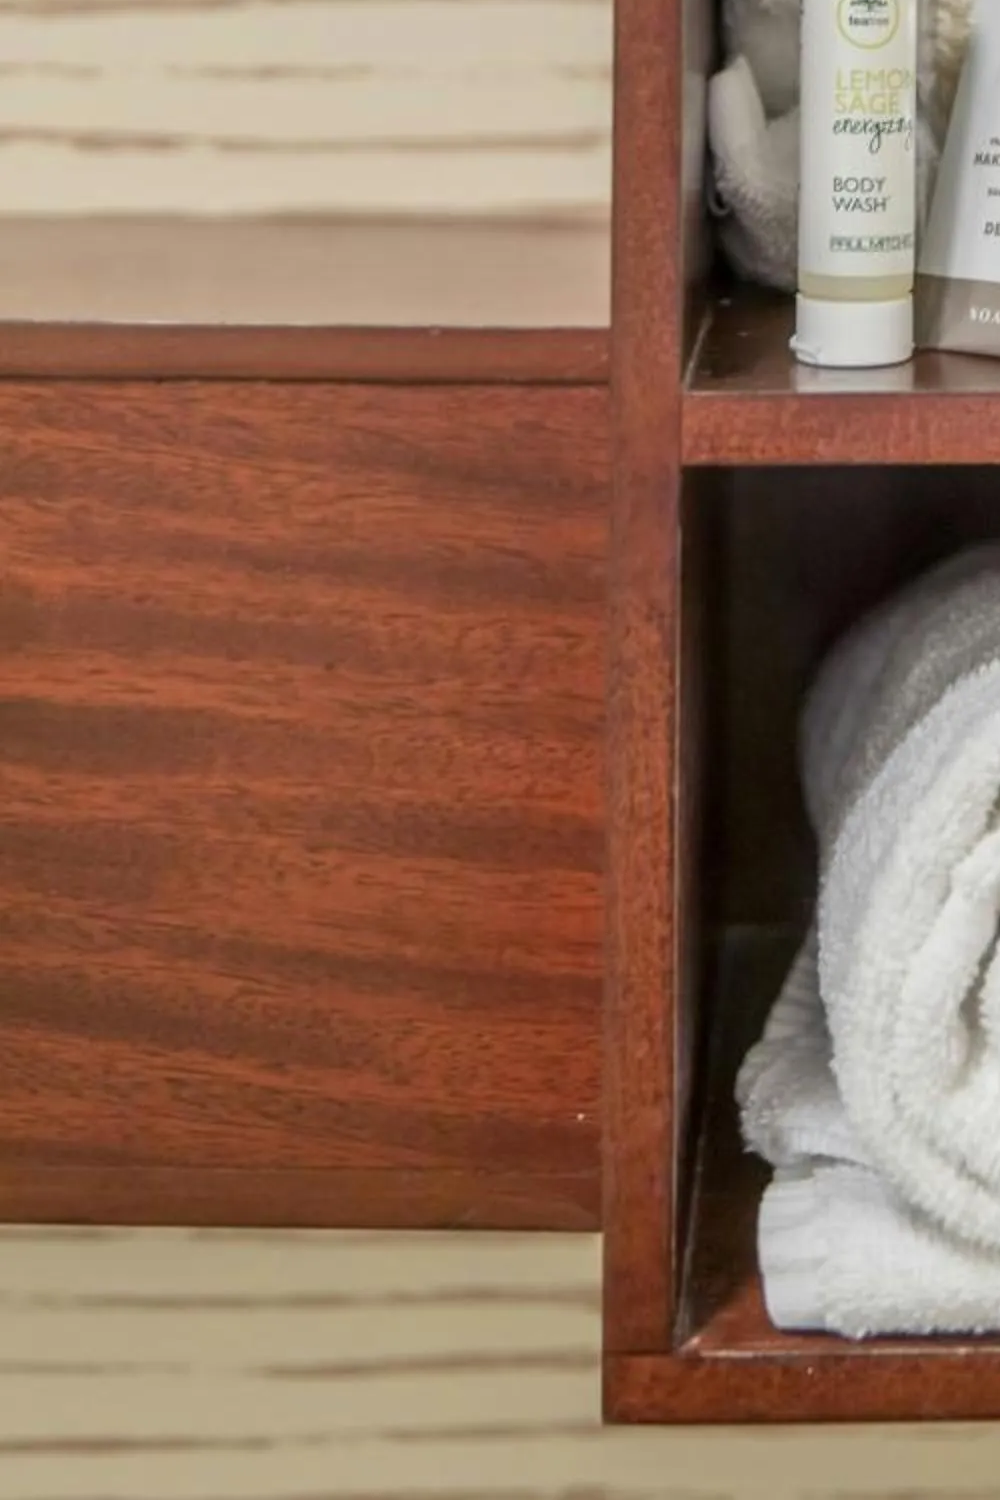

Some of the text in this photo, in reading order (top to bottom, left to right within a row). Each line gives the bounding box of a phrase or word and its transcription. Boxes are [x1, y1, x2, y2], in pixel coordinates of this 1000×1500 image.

[834, 93, 901, 114] SAGE
[833, 176, 887, 193] BODY
[832, 196, 889, 213] WASH
